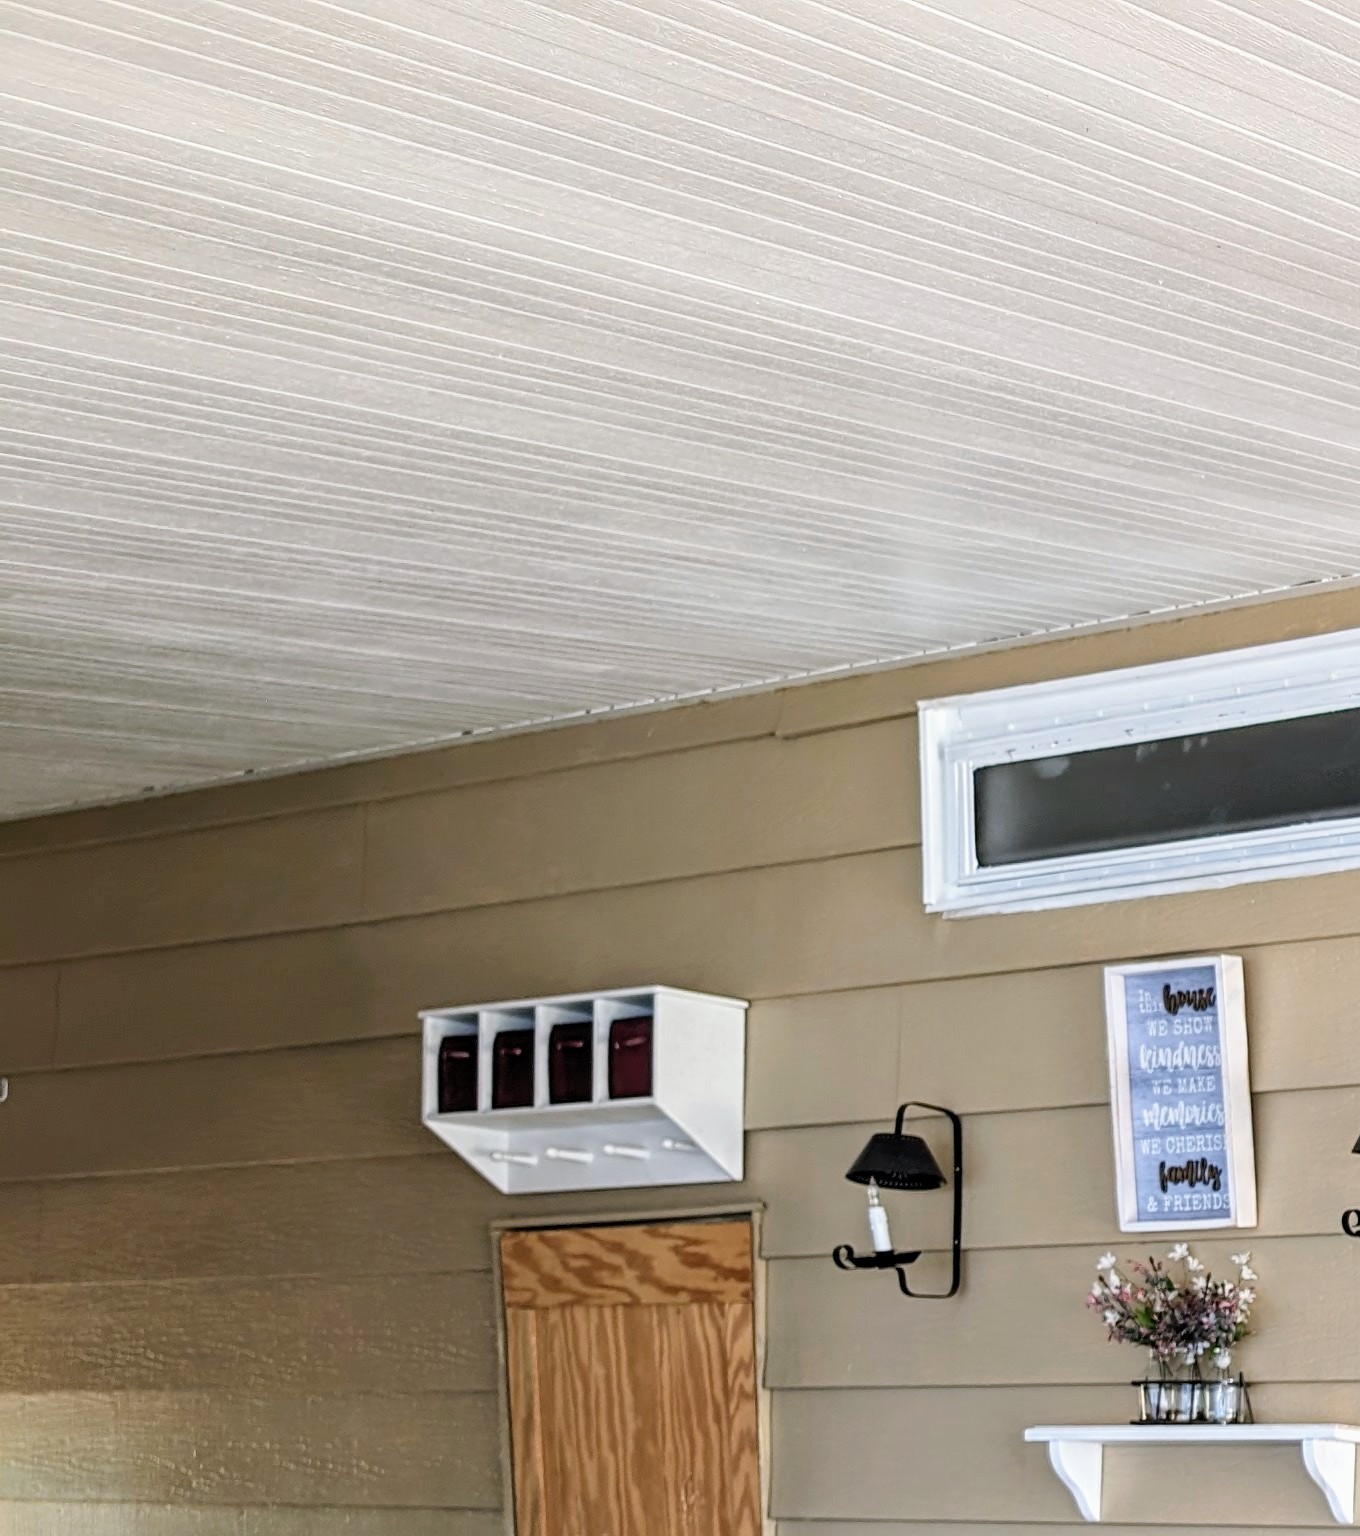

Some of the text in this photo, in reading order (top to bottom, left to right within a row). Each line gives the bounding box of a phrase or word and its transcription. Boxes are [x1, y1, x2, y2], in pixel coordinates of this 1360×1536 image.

[1138, 989, 1152, 1002] In
[1162, 983, 1217, 1015] house
[1147, 1016, 1213, 1037] WE SHOW
[1140, 1040, 1221, 1073] kindness
[1152, 1075, 1216, 1095] WE MAKE
[1143, 1100, 1225, 1131] memories
[1140, 1133, 1226, 1155] WE CHERIS
[1159, 1157, 1222, 1193] family
[1147, 1192, 1230, 1212] & FRIENDS
